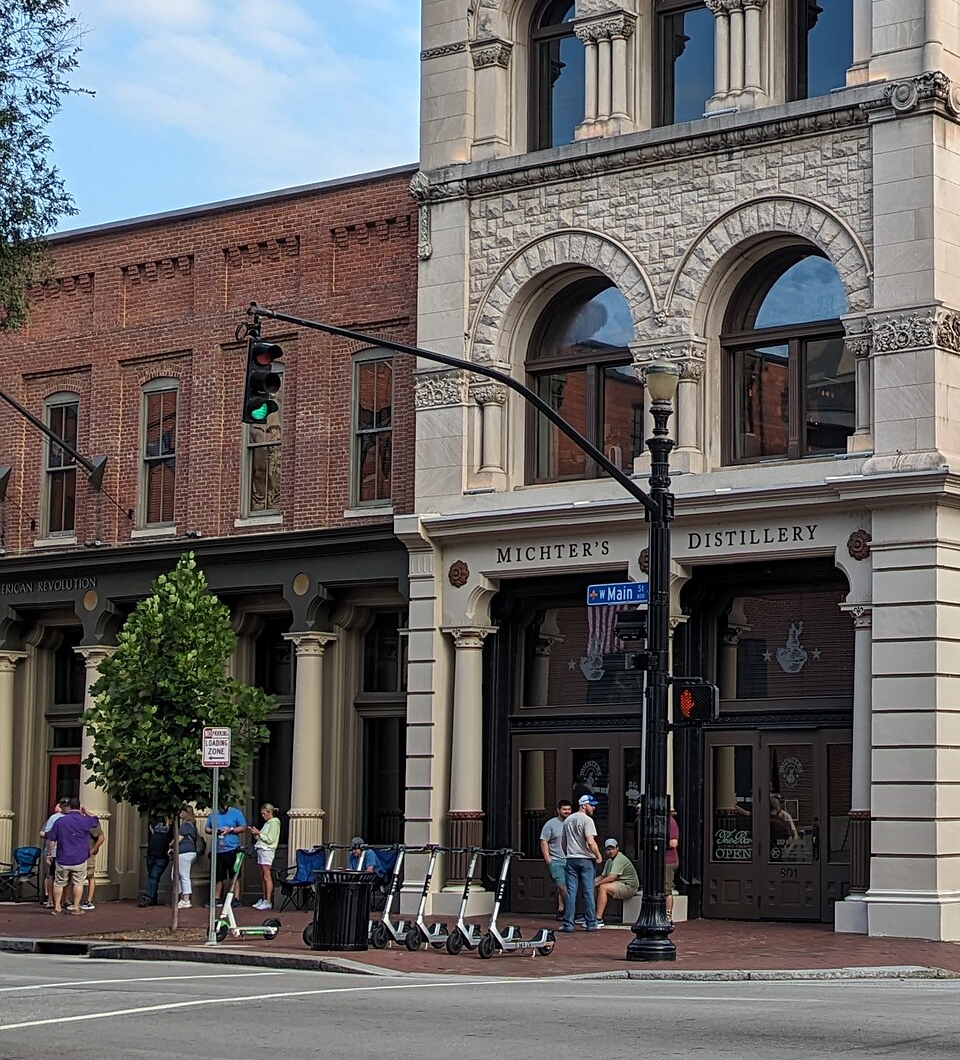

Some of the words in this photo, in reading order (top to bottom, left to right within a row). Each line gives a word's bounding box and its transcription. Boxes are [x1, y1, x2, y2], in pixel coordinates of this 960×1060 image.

[496, 540, 609, 564] MICHTER'S
[688, 524, 818, 550] DISTILLERY
[38, 577, 96, 592] REVOLUTION
[599, 589, 606, 600] W
[607, 585, 633, 601] Main
[637, 584, 645, 593] St
[715, 848, 752, 860] OPEN
[780, 867, 798, 879] 801
